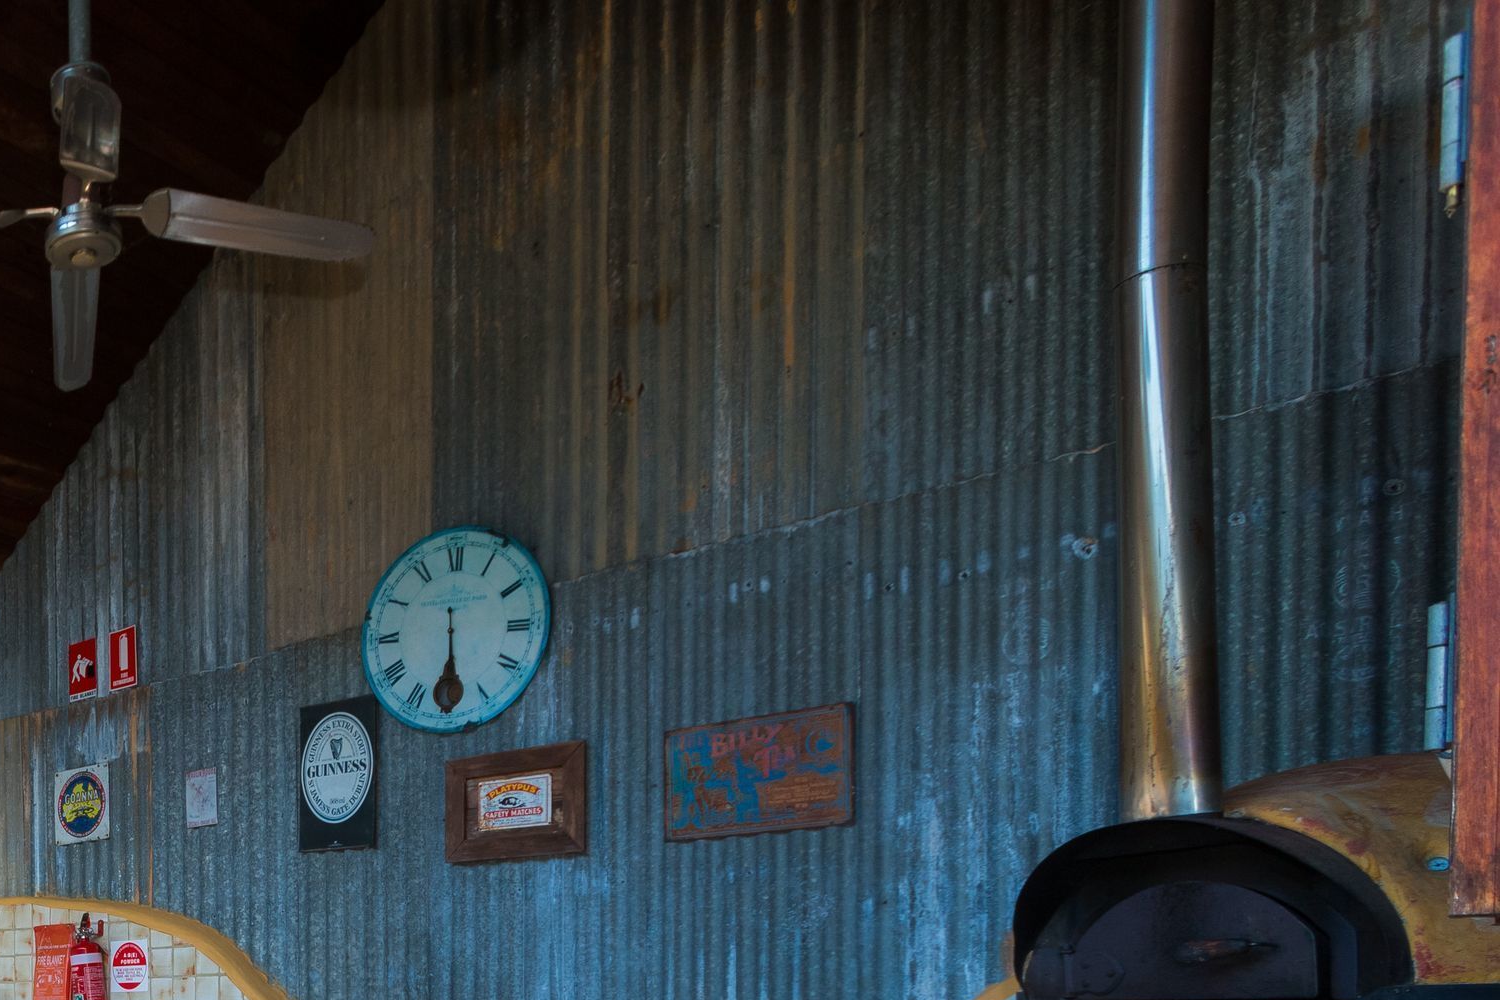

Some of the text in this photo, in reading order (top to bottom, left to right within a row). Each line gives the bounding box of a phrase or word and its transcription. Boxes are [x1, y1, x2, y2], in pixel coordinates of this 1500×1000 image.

[500, 578, 523, 599] II
[507, 618, 530, 632] III
[308, 719, 367, 763] GUINNESS EXTRA STOUT
[711, 723, 785, 758] BILLY
[307, 758, 367, 779] GUINNESS
[64, 789, 99, 805] GOANNA
[331, 803, 351, 816] GATE
[349, 772, 367, 804] DUBLIN
[488, 783, 537, 800] PLATYPUS
[485, 806, 542, 819] SAFETY MATCHES
